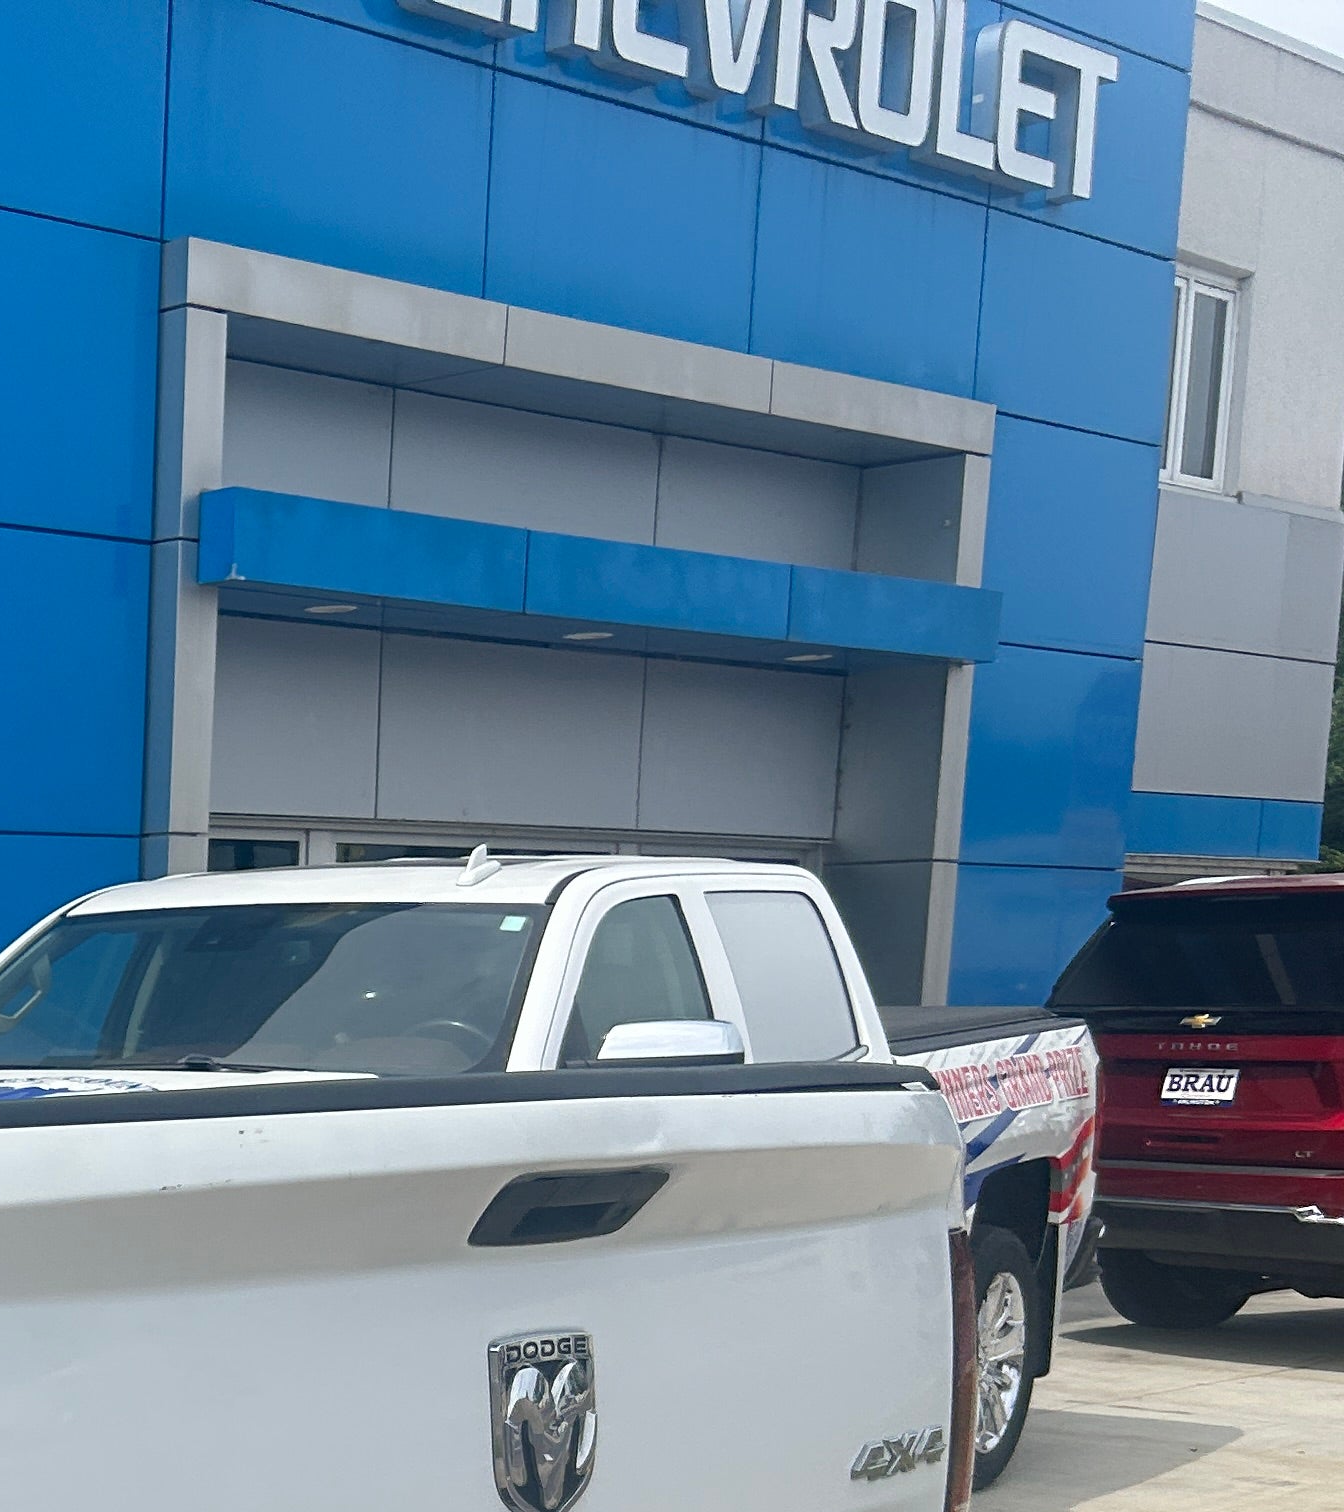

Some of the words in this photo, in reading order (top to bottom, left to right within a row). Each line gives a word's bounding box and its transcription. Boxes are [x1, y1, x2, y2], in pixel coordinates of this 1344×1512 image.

[1157, 1042, 1239, 1052] TAHOE
[1167, 1074, 1234, 1092] BRAU
[505, 1335, 587, 1362] DODGE
